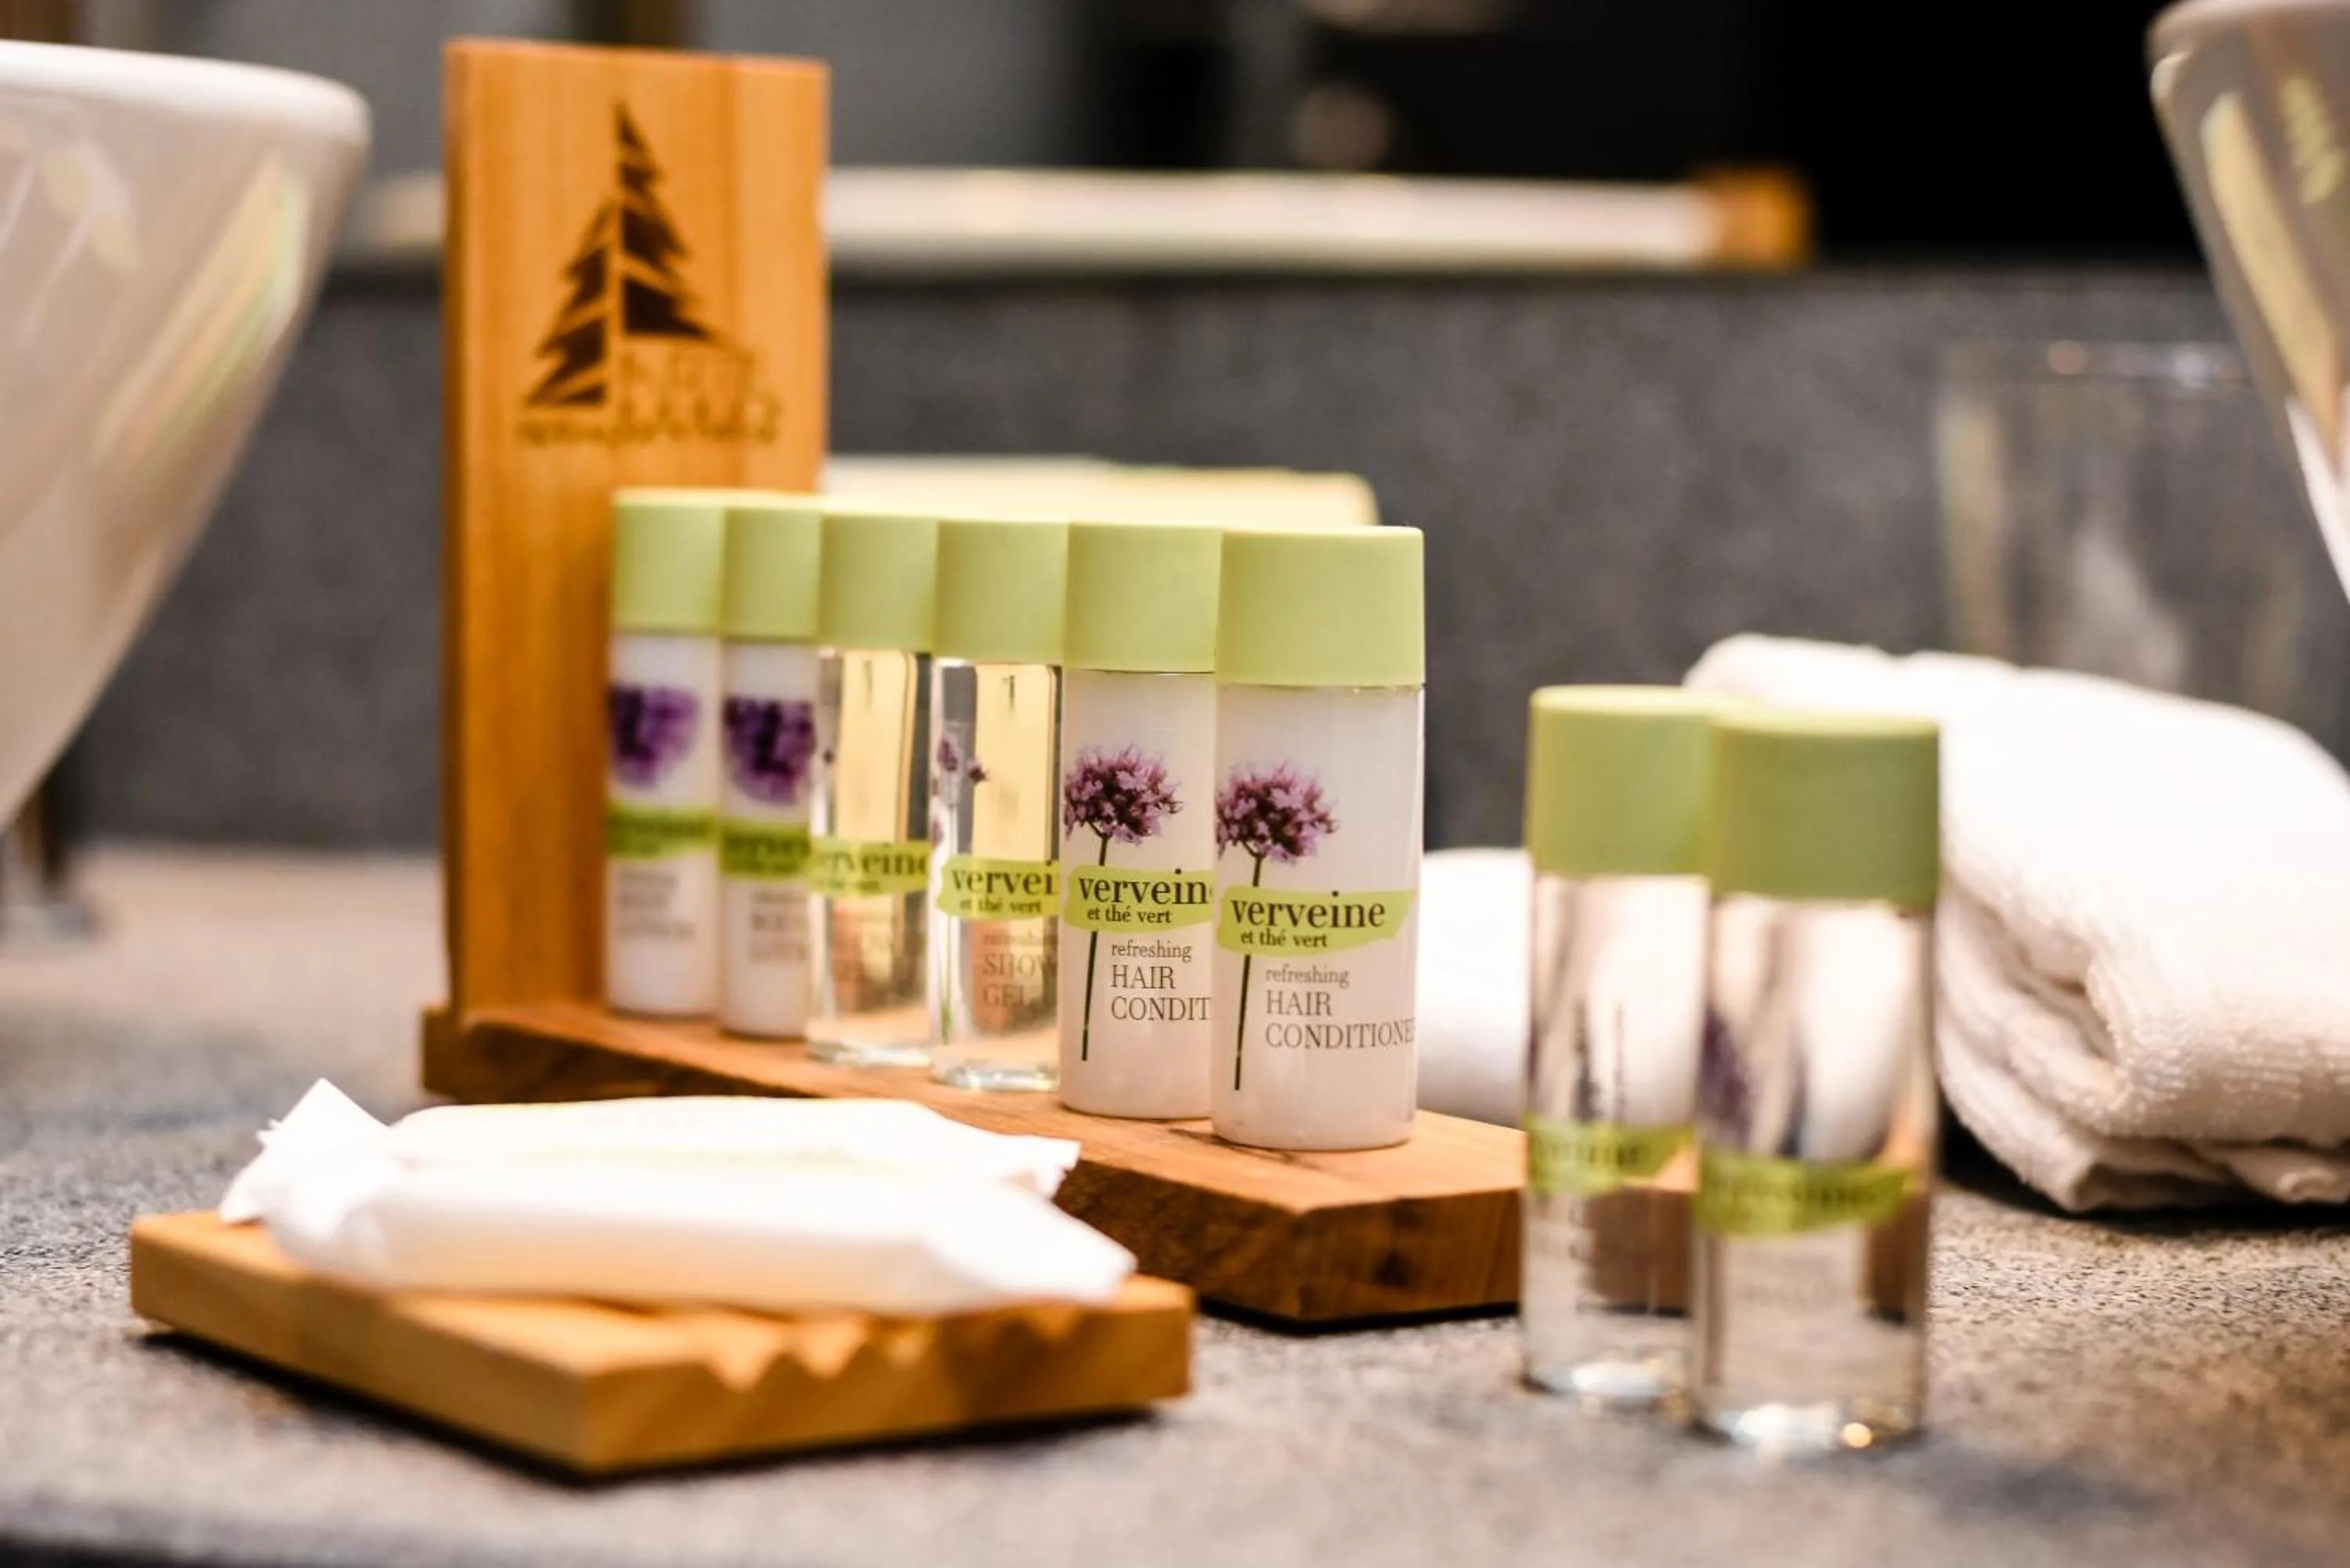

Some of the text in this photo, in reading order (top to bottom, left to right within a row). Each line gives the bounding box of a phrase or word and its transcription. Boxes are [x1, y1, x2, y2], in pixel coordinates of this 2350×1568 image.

[952, 860, 1058, 895] vervei
[1078, 869, 1213, 905] vervein
[1087, 905, 1171, 923] et thé vert
[1231, 891, 1386, 929] verveine
[1240, 928, 1328, 948] et thé vert
[1111, 940, 1191, 963] refreshing
[1111, 964, 1176, 990] HAIR
[1265, 964, 1350, 988] refreshing
[1111, 995, 1212, 1021] CONDIT
[1266, 989, 1332, 1017] HAIR
